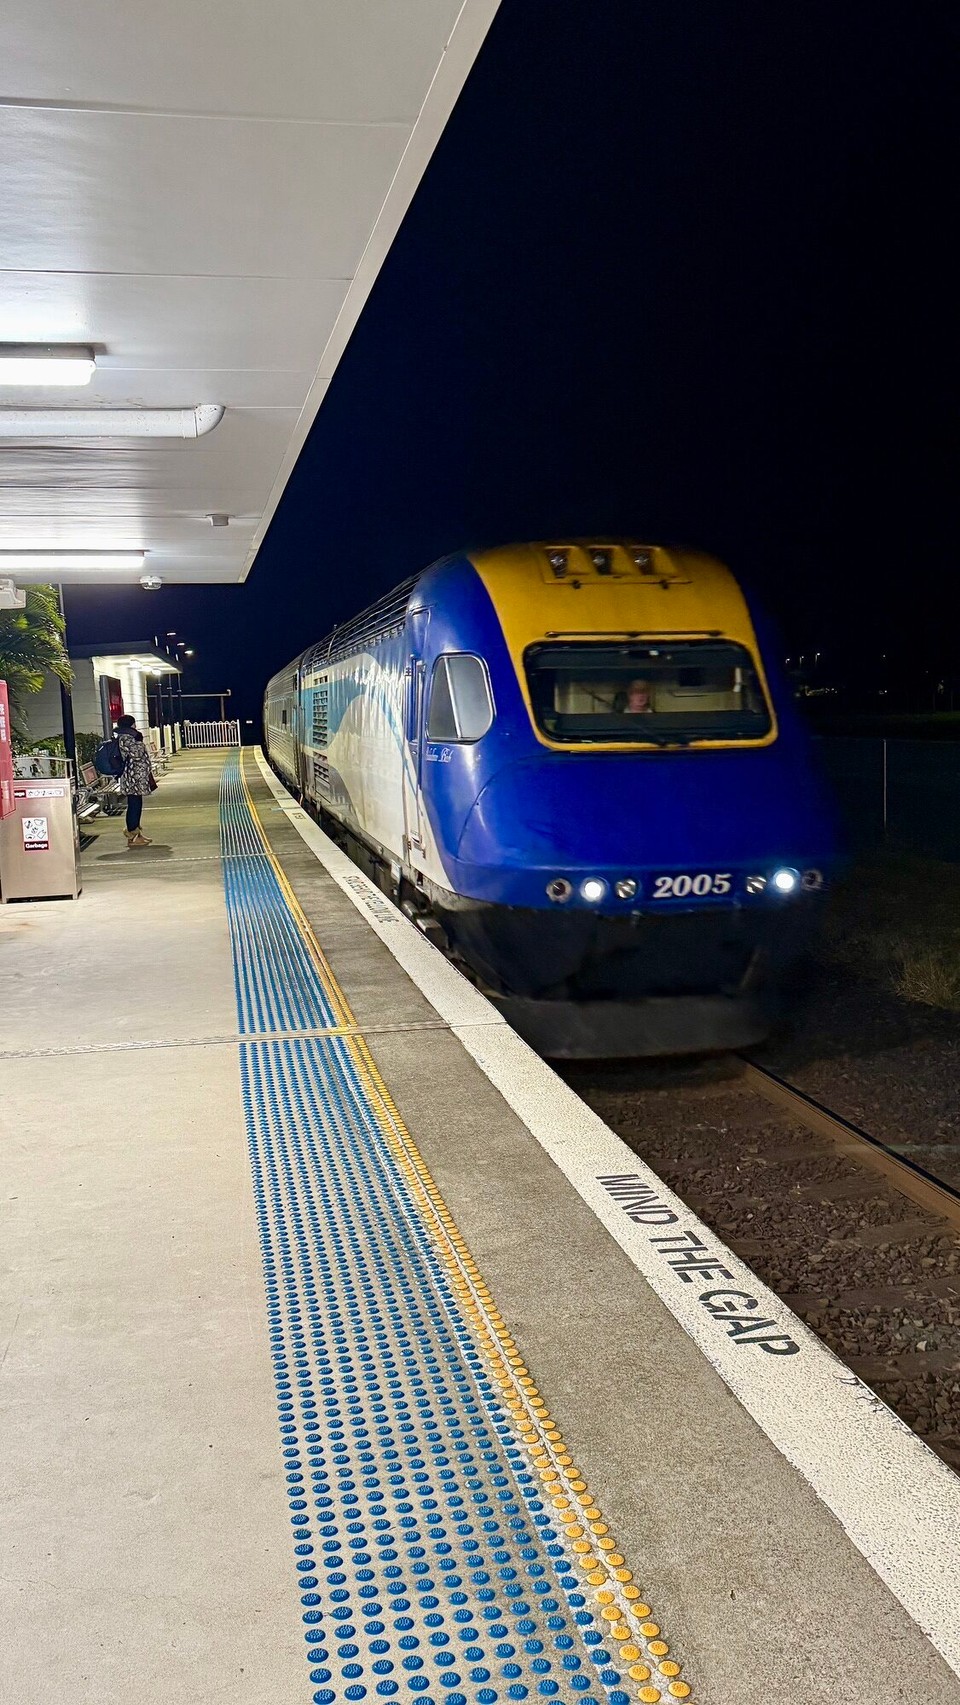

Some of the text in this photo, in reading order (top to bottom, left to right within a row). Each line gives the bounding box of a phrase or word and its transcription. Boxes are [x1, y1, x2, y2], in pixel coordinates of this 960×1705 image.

[653, 873, 732, 898] 2005
[595, 1173, 801, 1356] MIND THE GAP
